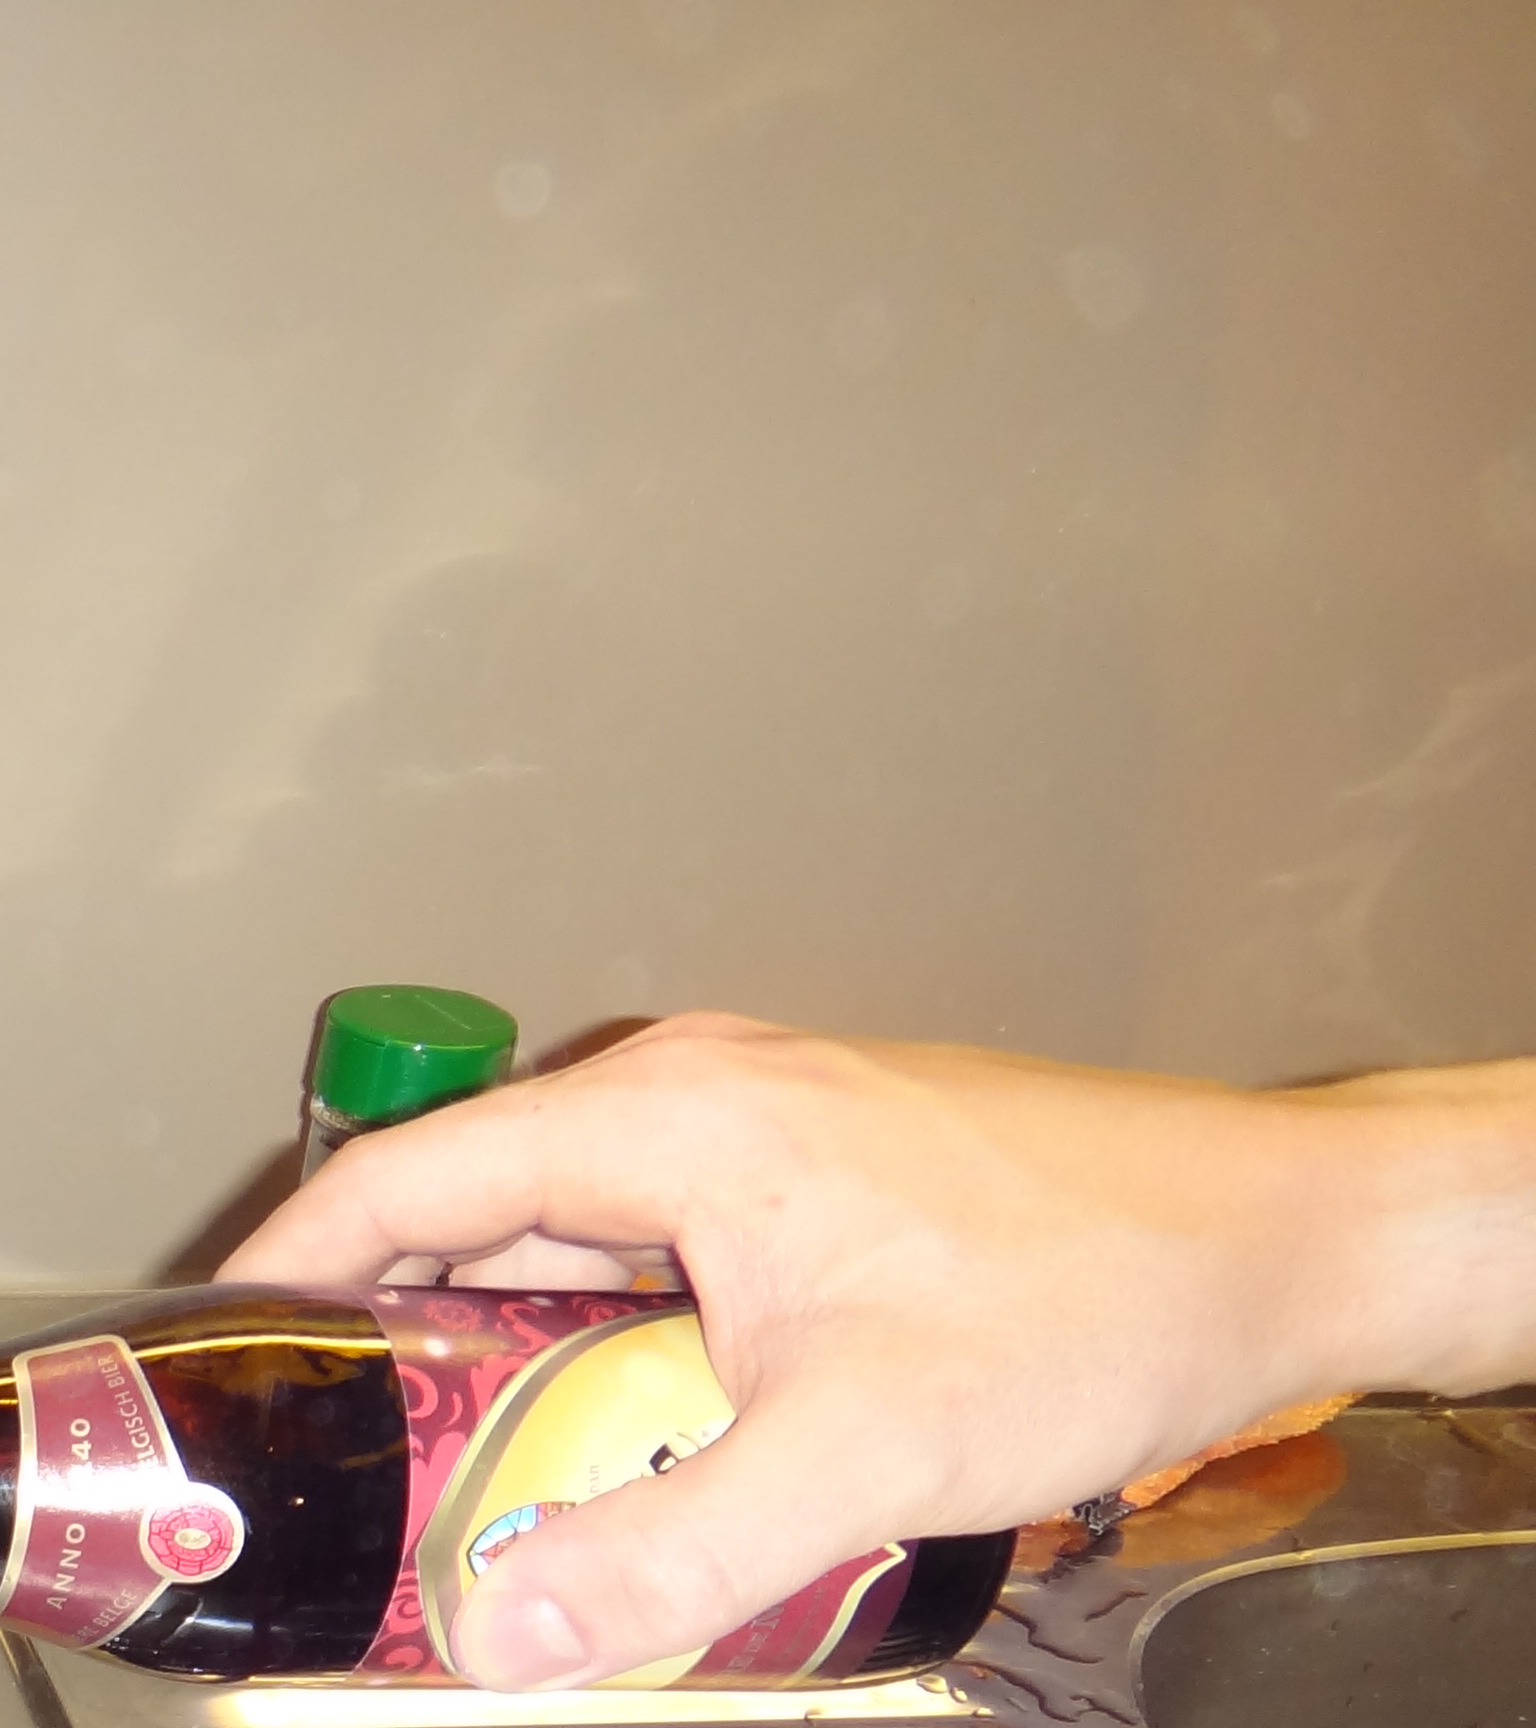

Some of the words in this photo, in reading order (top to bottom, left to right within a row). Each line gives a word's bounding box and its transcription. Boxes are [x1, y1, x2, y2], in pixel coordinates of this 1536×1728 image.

[97, 1354, 126, 1389] BIER
[114, 1390, 161, 1470] ELGISCH
[46, 1523, 86, 1611] ANNO
